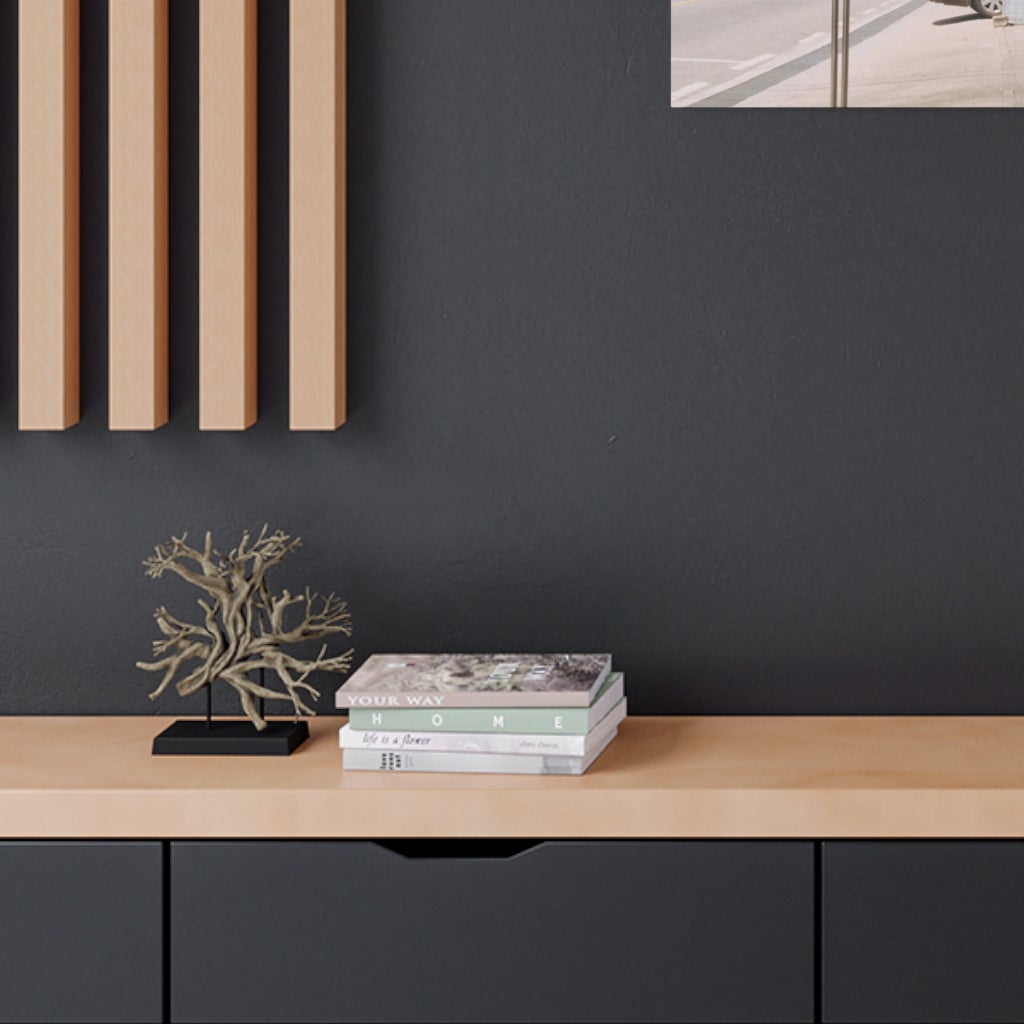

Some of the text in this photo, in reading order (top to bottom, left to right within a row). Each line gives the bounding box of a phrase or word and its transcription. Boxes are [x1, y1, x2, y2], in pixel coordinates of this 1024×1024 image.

[347, 696, 444, 706] YOUR WAY
[402, 733, 431, 748] flower
